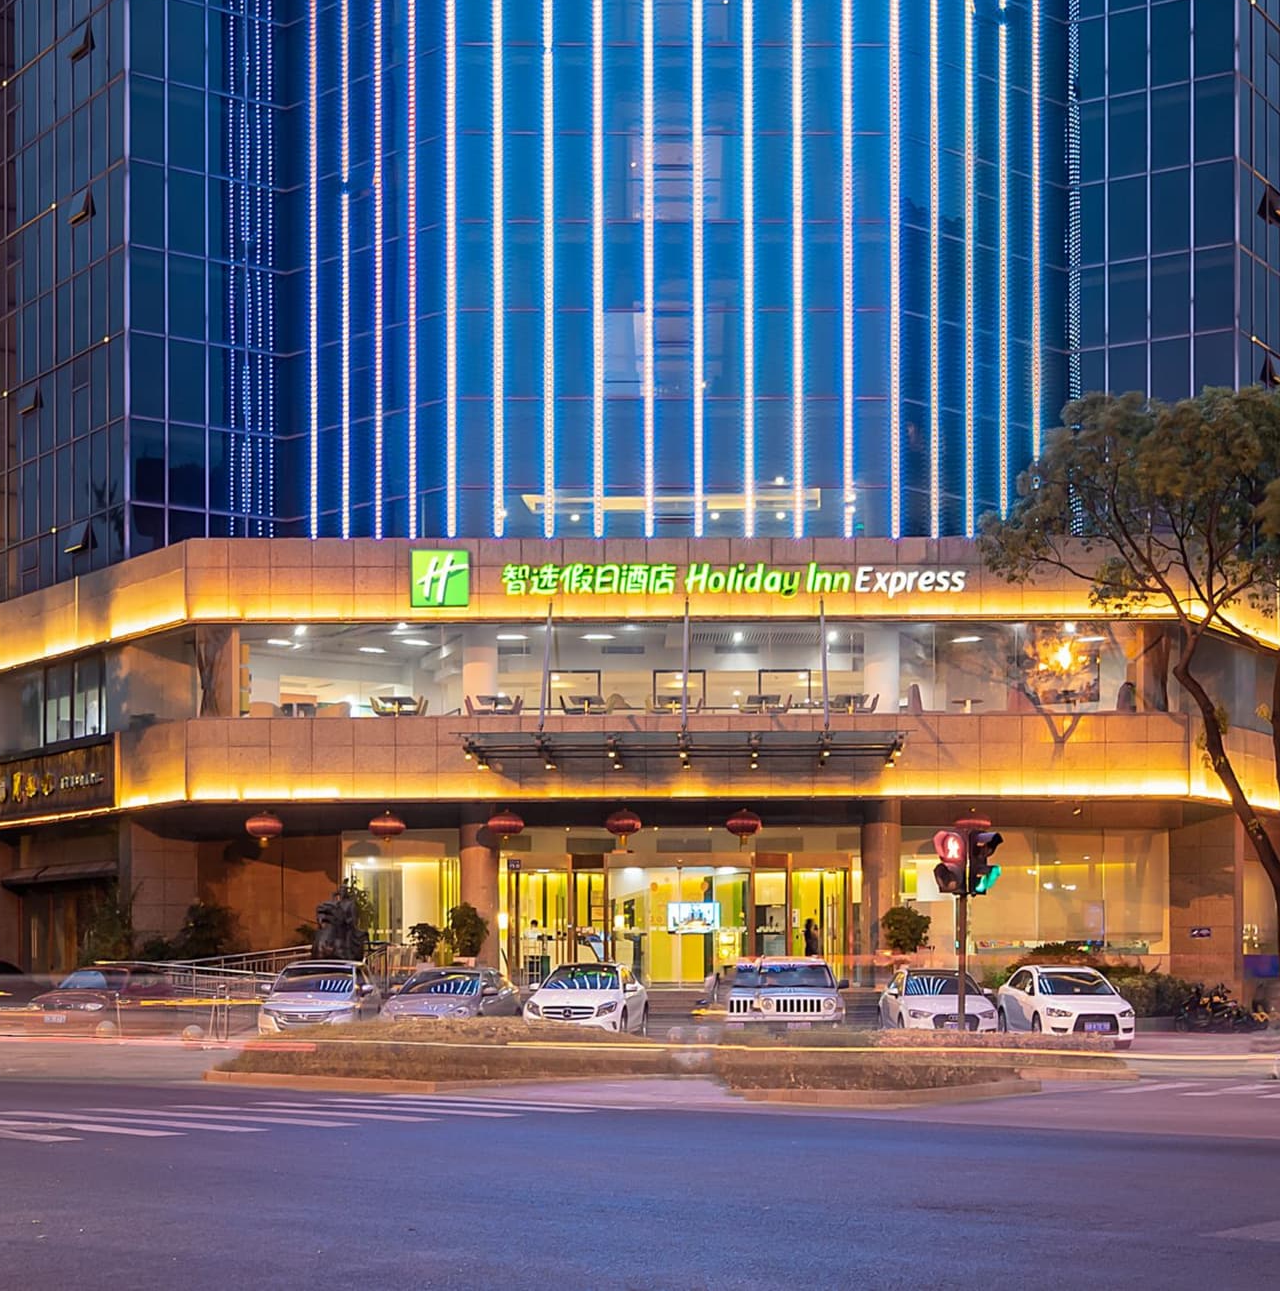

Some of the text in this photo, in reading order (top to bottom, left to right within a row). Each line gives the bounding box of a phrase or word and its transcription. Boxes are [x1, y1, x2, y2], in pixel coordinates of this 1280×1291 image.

[502, 561, 967, 599] 智选假日酒店 Holiday Inn Express
